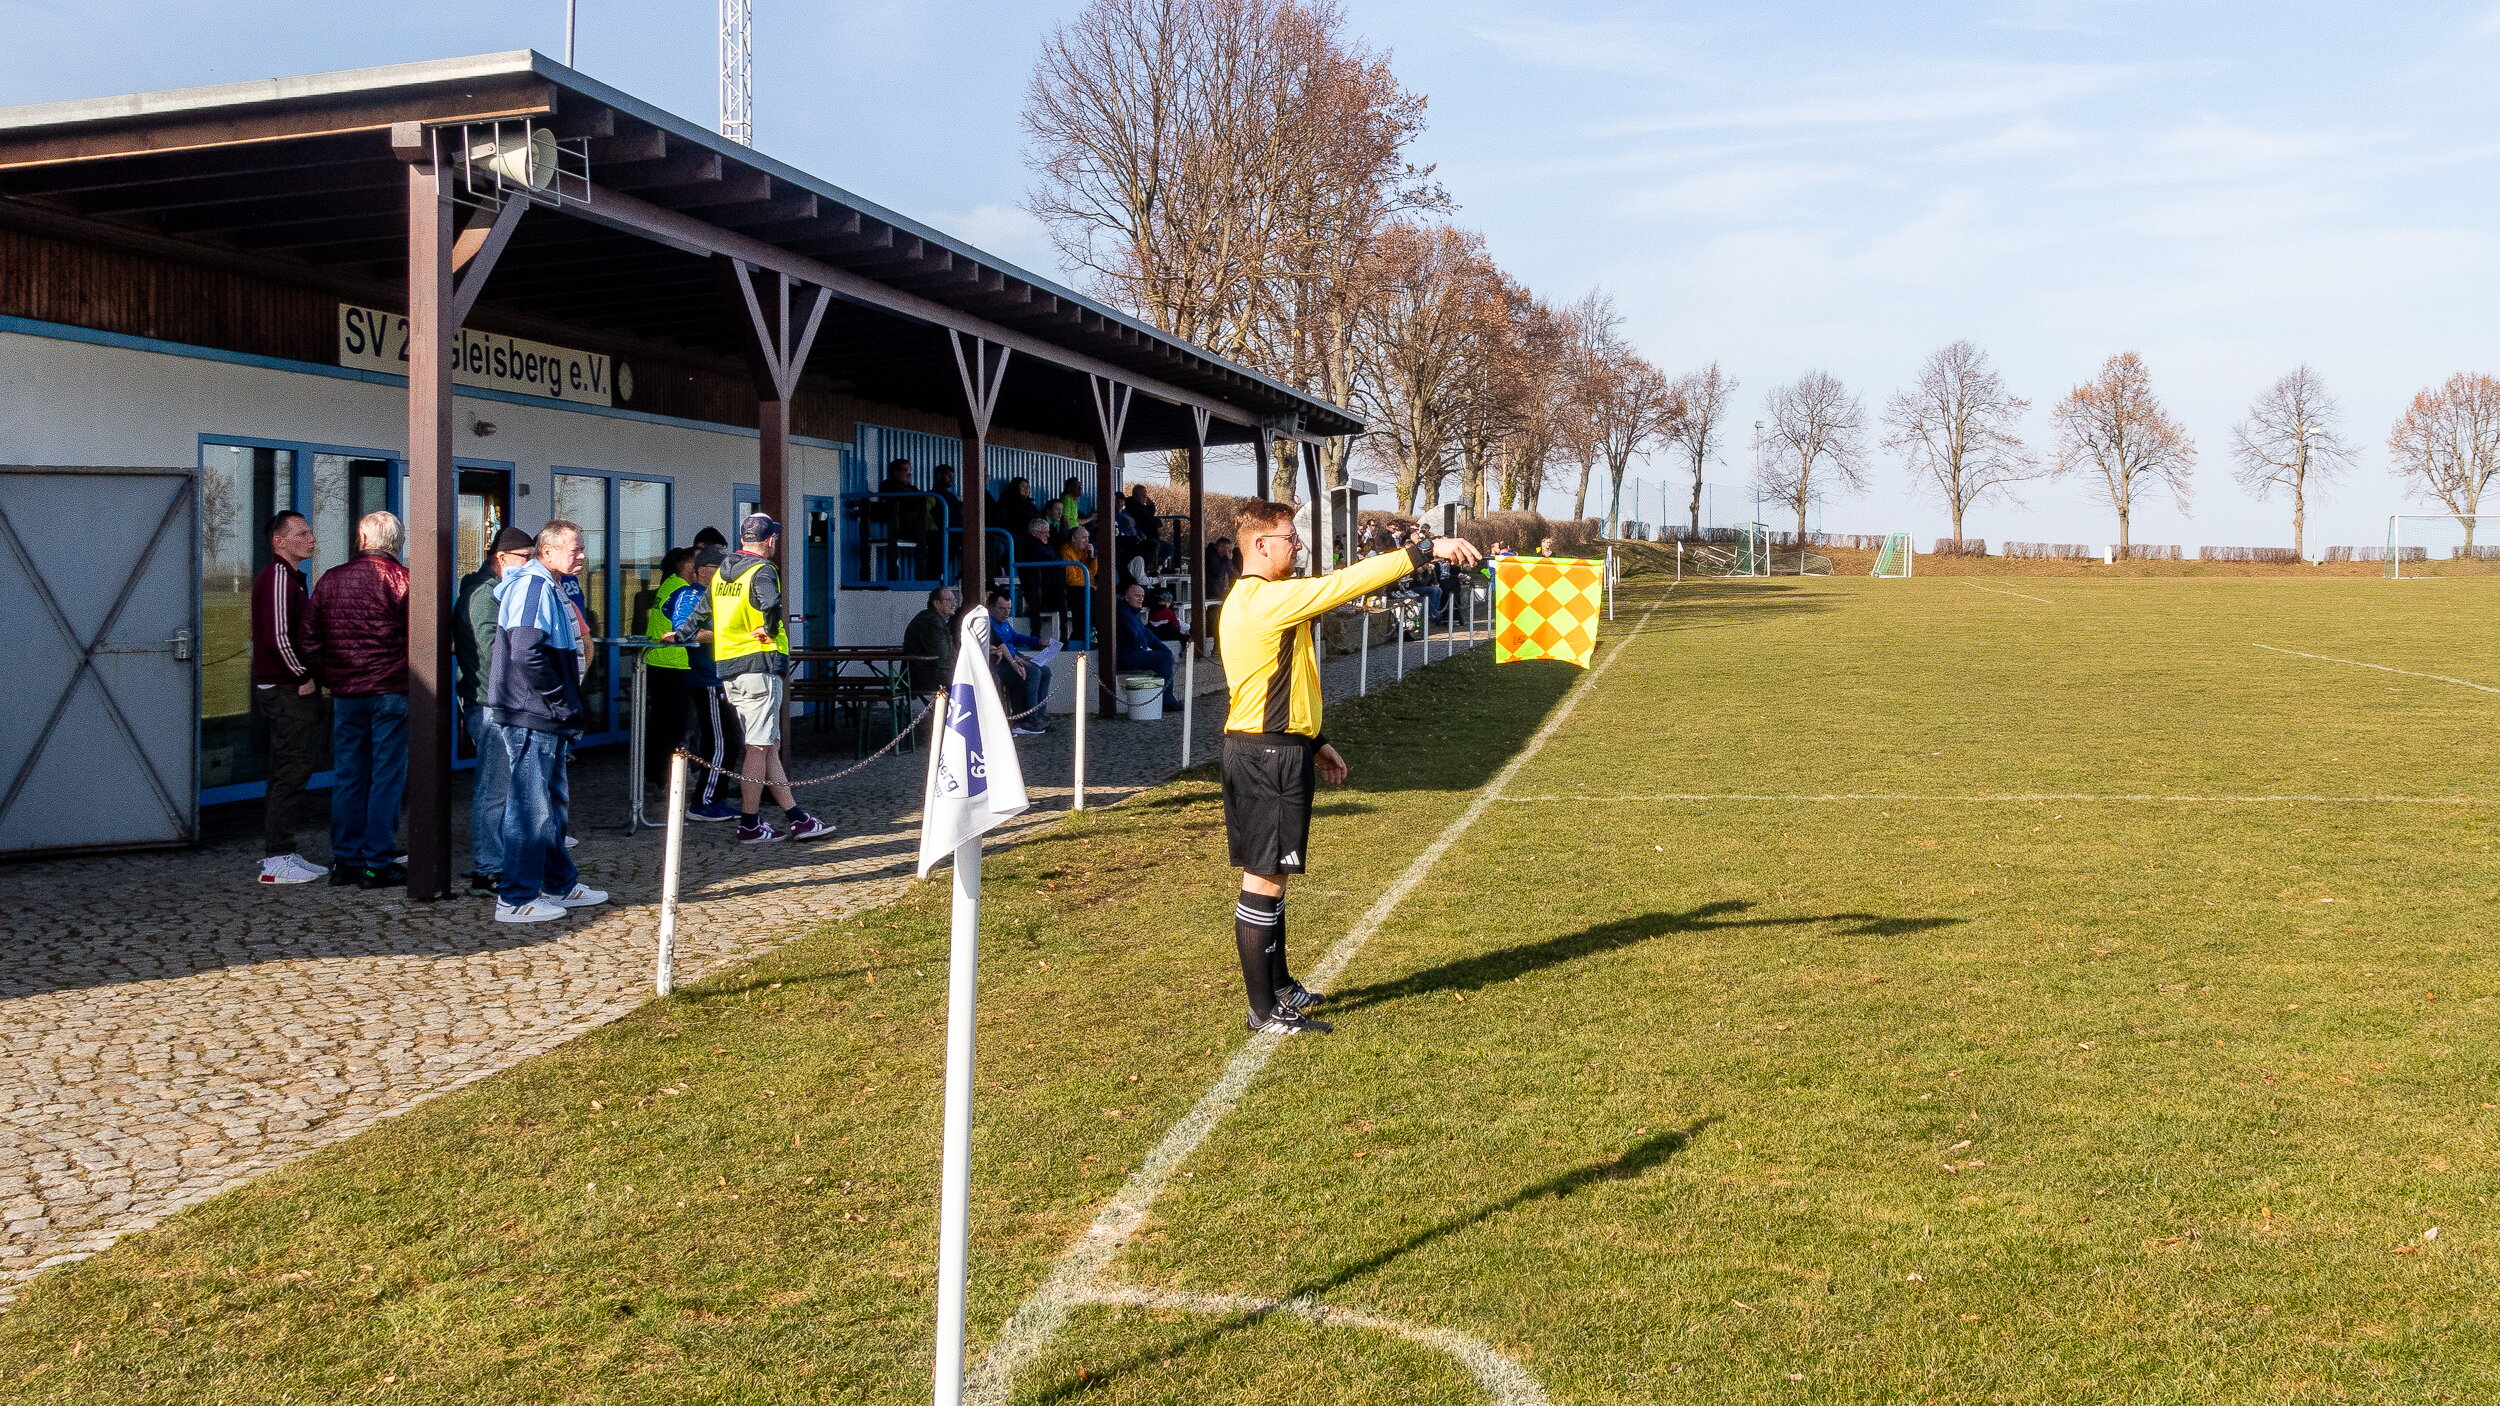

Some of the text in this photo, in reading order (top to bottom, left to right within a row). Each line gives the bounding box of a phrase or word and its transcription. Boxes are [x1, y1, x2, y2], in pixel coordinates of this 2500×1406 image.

[345, 307, 387, 358] SV
[398, 317, 410, 362] 2
[569, 353, 607, 394] e.V.
[563, 580, 580, 596] 29
[939, 753, 960, 792] berg
[970, 750, 987, 778] 29
